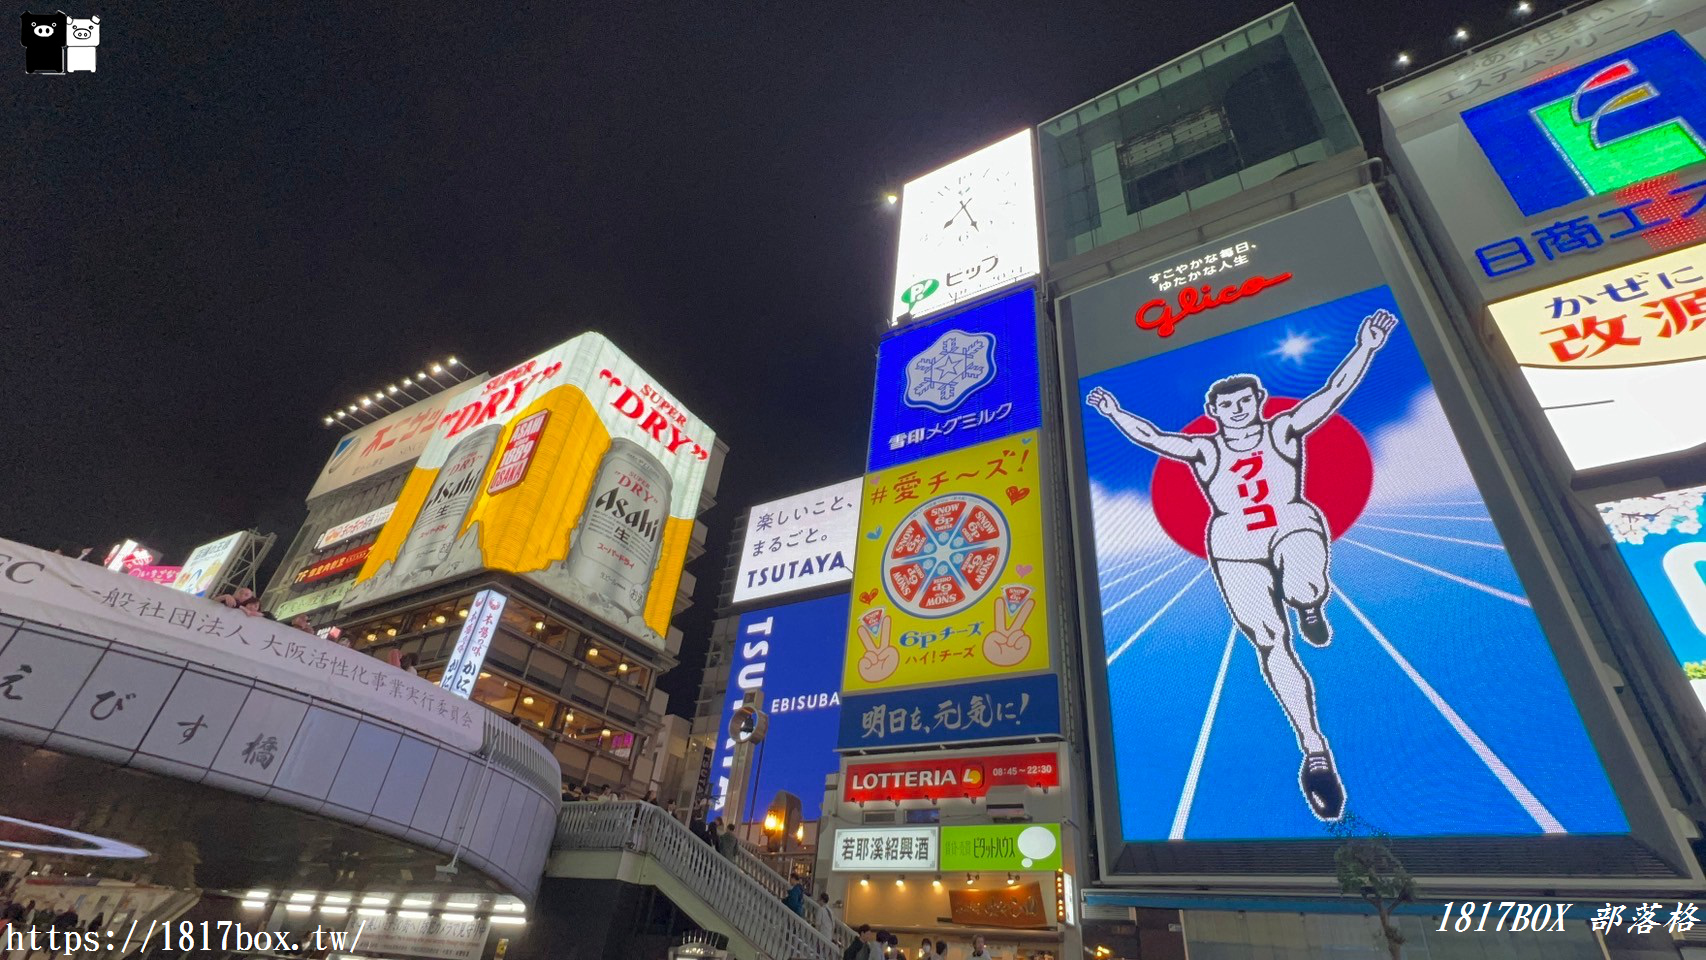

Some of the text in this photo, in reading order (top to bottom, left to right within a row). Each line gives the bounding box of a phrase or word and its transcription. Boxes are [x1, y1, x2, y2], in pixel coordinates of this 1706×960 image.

[1149, 241, 1257, 284] すこやかな毎日、
[1158, 254, 1249, 291] ゆたかな人生
[1544, 266, 1704, 319] かぜに
[640, 384, 687, 428] SUPER
[510, 413, 546, 443] ASAHI
[888, 402, 1013, 451] 雪印メグミルク
[424, 468, 483, 512] Asahi
[489, 462, 524, 490] OSAKA
[1228, 450, 1278, 532] グリコ
[595, 486, 660, 543] Asahi
[756, 496, 853, 532] 楽しいこと、
[931, 503, 960, 517] SNOW
[975, 511, 997, 534] SNOW
[613, 526, 631, 545] 生
[752, 528, 828, 557] まるごと。
[895, 525, 915, 554] SNOW
[747, 551, 845, 588] TSUTAYA
[892, 571, 912, 596] SNOW
[975, 554, 996, 584] SNOW
[925, 593, 957, 607] SNOW
[472, 613, 494, 657] 本場の味
[71, 583, 250, 646] 一般社団法人
[262, 634, 474, 730] 大阪活性化事業実行委員会
[456, 660, 477, 694] かに
[852, 769, 957, 790] LOTTERIA
[841, 836, 930, 861] 若耶溪紹興酒
[973, 836, 1016, 859] ピタットハウス
